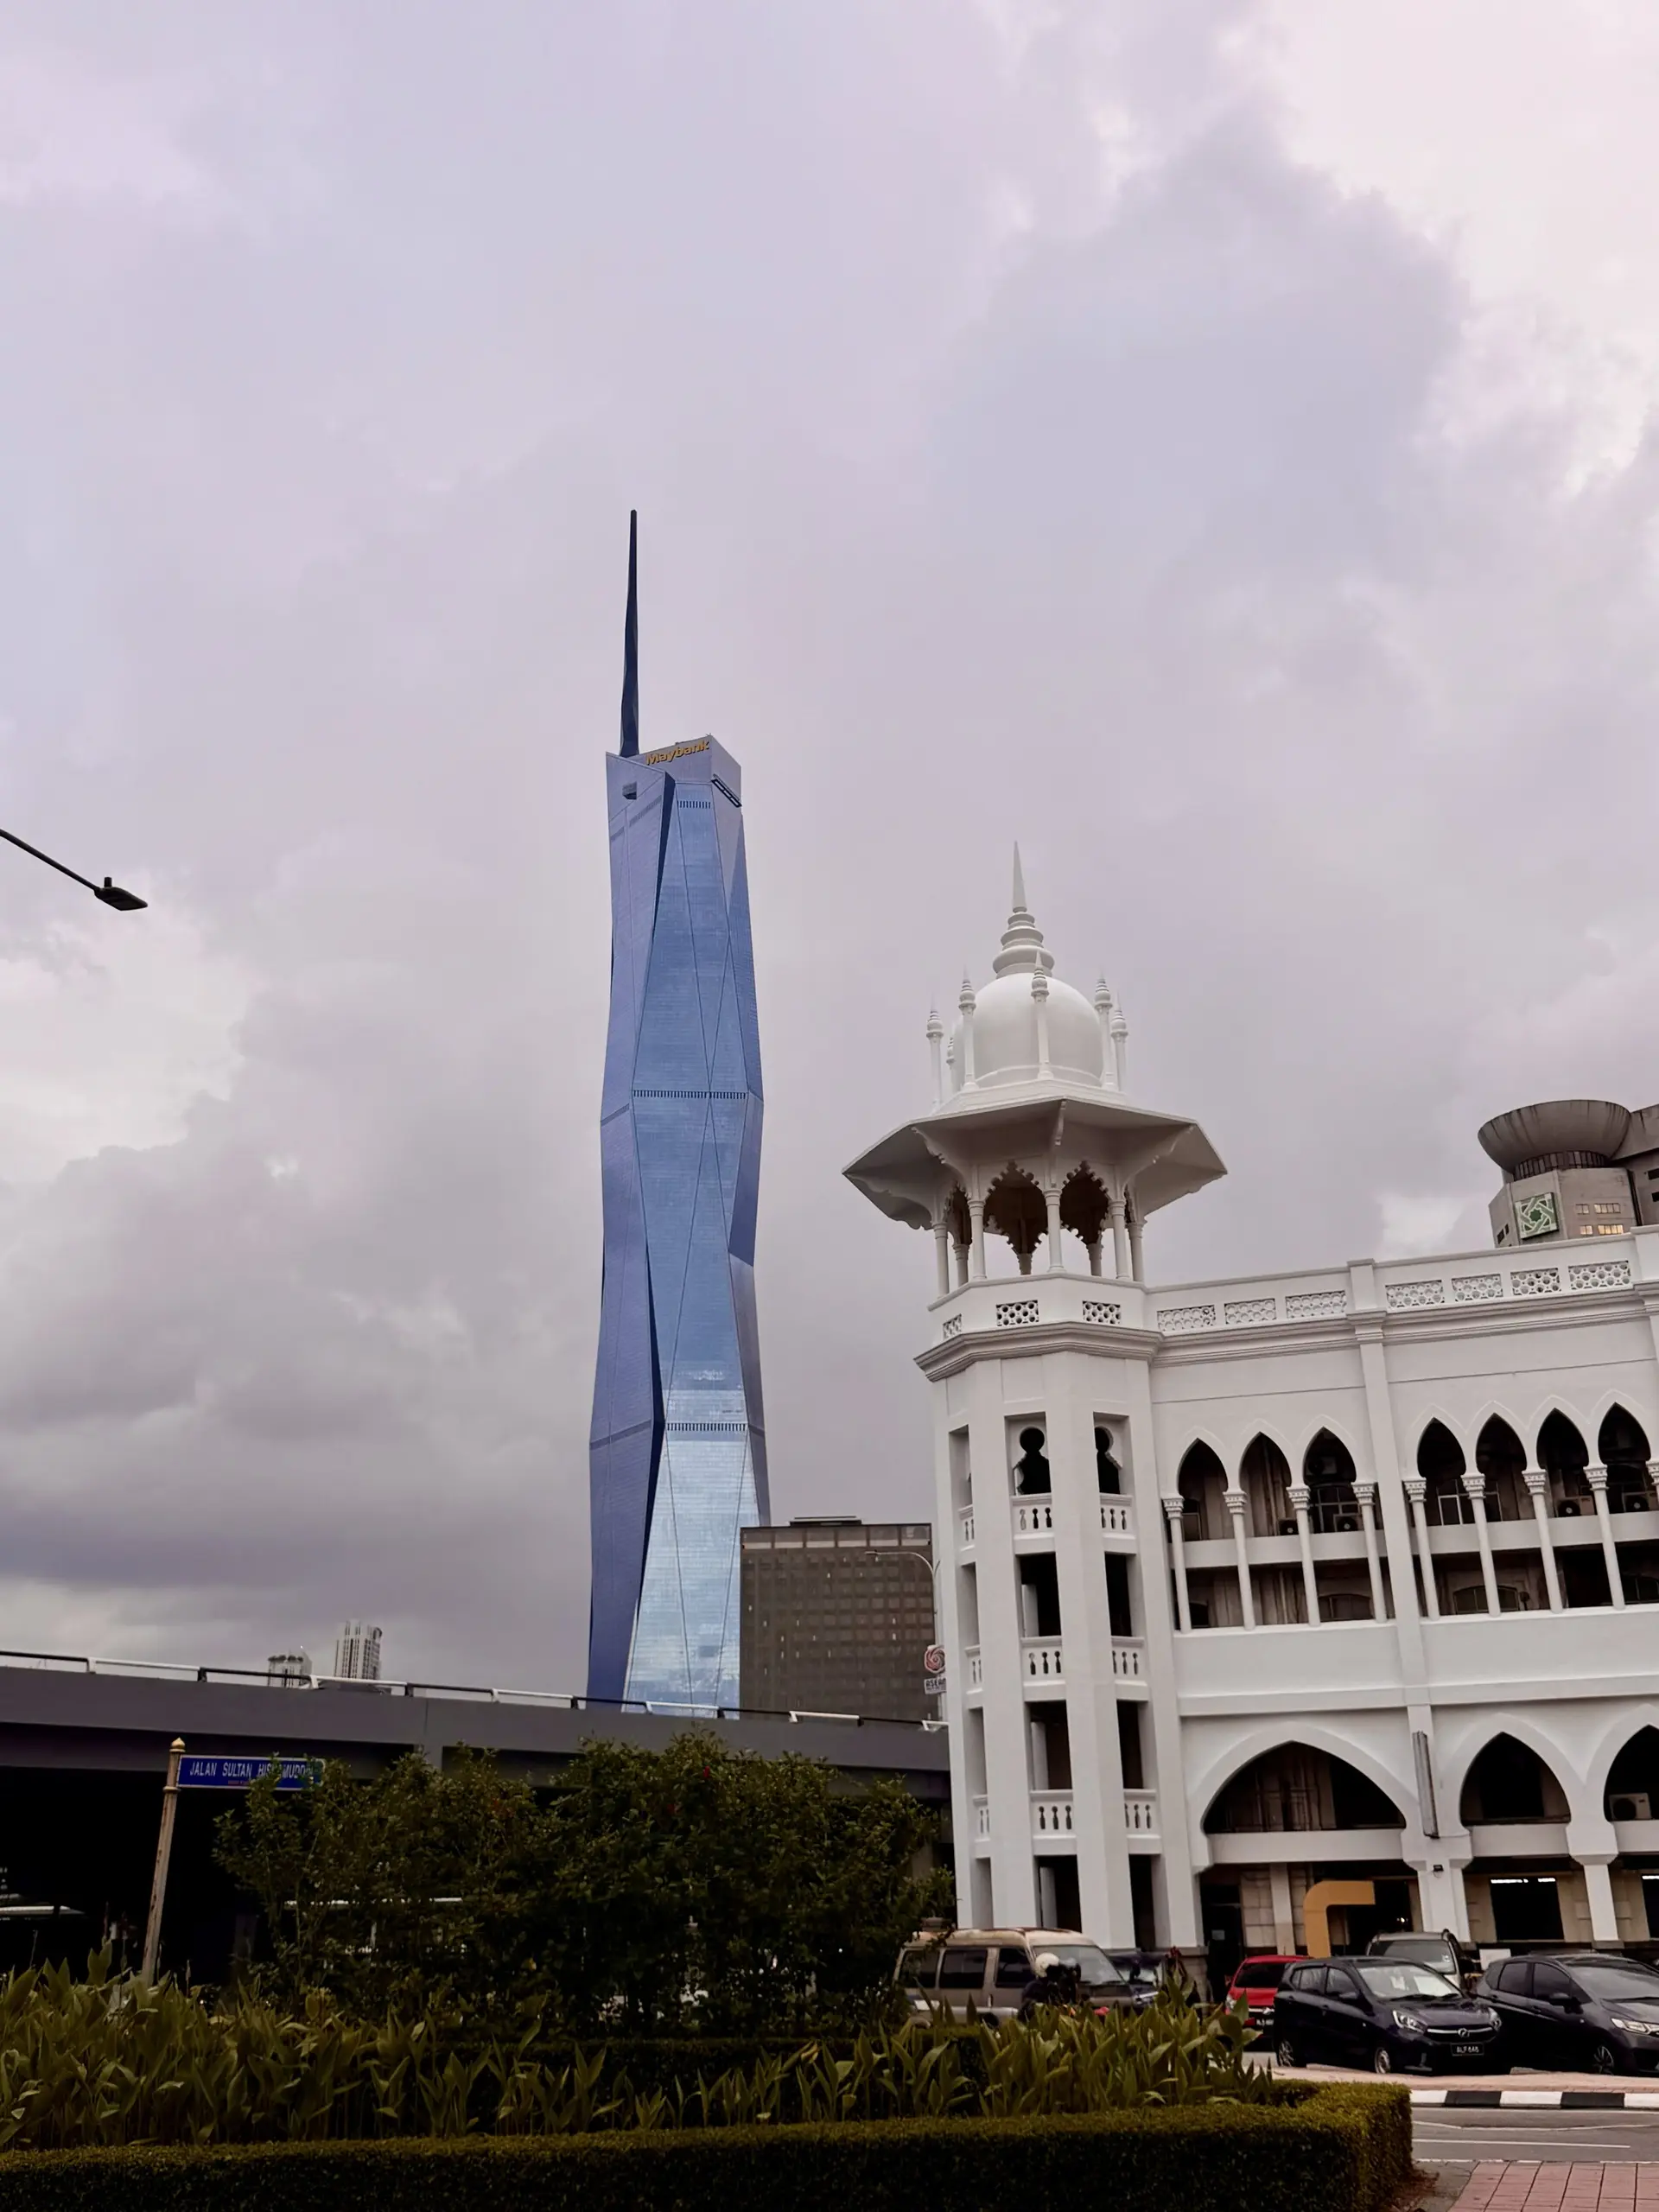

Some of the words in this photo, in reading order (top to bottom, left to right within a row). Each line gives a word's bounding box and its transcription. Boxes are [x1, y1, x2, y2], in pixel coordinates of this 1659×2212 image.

[645, 740, 710, 766] Maybank
[189, 1761, 218, 1777] JALAN
[222, 1762, 253, 1778] SULTAN
